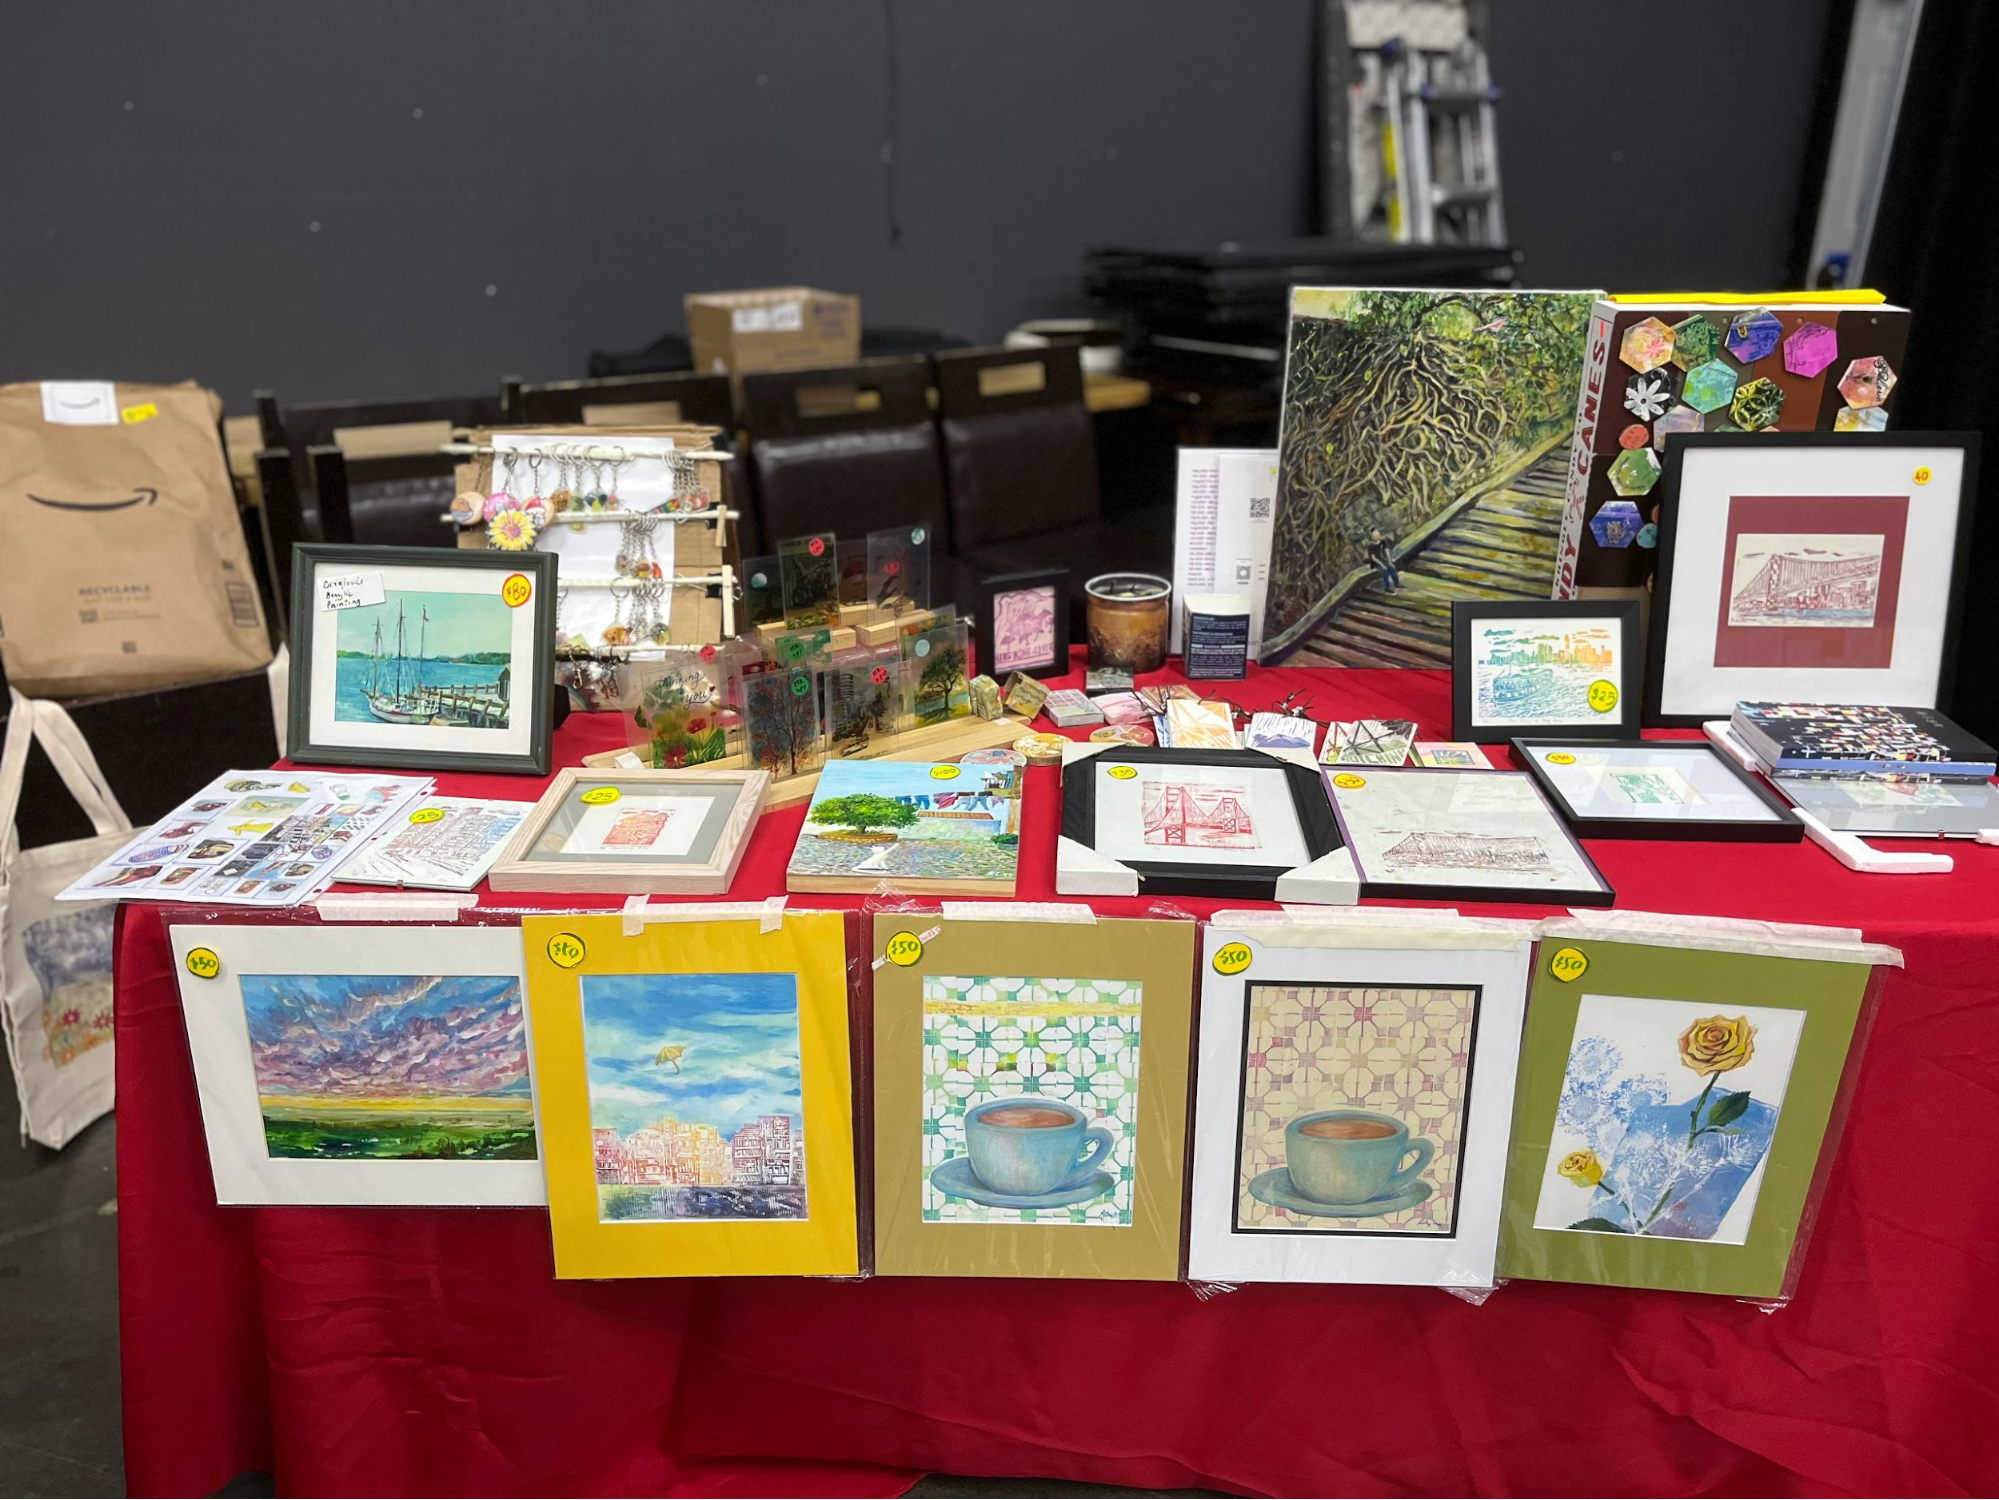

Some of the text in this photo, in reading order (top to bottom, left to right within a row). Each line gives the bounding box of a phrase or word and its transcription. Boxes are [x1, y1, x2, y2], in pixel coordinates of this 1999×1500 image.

[1577, 339, 1606, 475] CANES
[1914, 470, 1929, 482] 40
[79, 584, 151, 596] RECYCLABLE
[506, 582, 527, 601] $80
[683, 690, 713, 711] you
[1590, 687, 1616, 706] $25
[585, 792, 613, 801] $25
[891, 940, 919, 955] $50
[190, 956, 217, 970] $50
[1219, 949, 1247, 965] $50
[1555, 955, 1584, 971] $50
